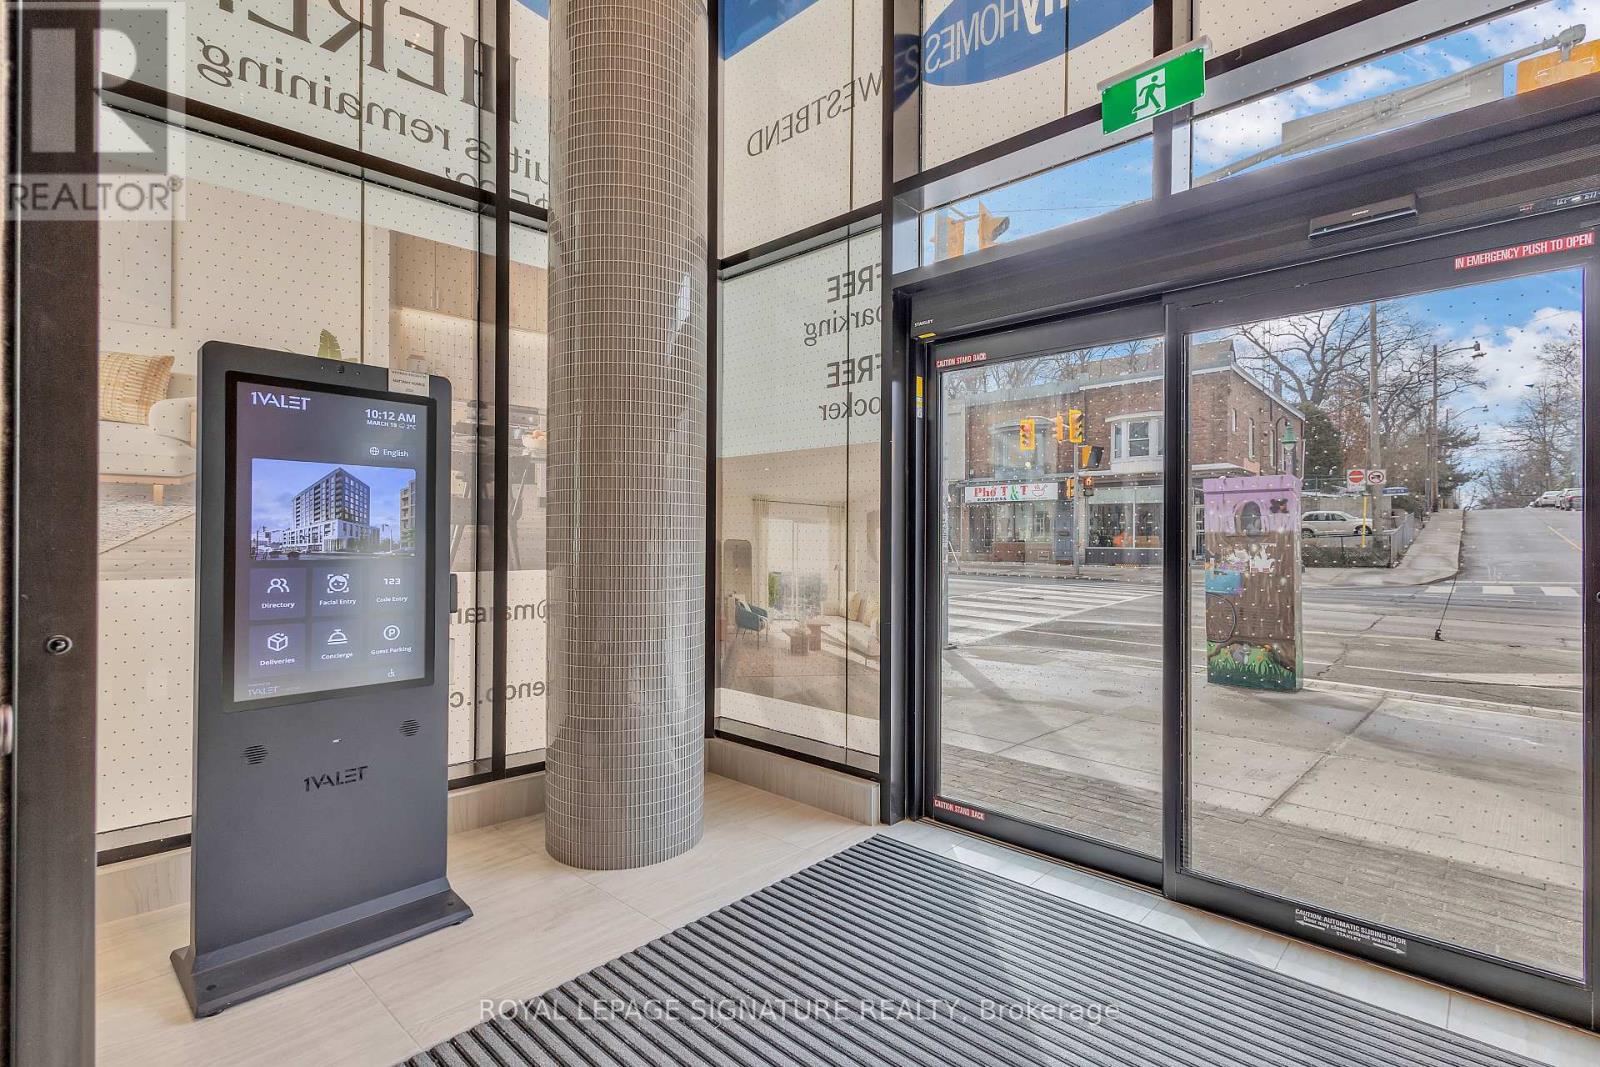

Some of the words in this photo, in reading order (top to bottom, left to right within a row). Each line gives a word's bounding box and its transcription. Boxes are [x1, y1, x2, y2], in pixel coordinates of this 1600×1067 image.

[1455, 258, 1465, 270] IN
[1467, 246, 1520, 267] EMERGENCY
[1522, 241, 1548, 257] PUSH
[1550, 238, 1564, 251] TO
[1566, 232, 1593, 248] OPEN
[935, 357, 956, 368] CAUTION
[250, 391, 311, 411] 1VALET
[364, 408, 396, 421] 10:12
[397, 412, 417, 424] AM
[366, 419, 389, 428] MARCH
[383, 447, 409, 458] English
[383, 577, 401, 585] 123
[389, 645, 412, 654] Parking
[259, 656, 296, 666] Deliveries
[321, 651, 354, 660] Concierge
[303, 765, 369, 792] 1VALET
[934, 799, 954, 812] CAUTION
[954, 805, 970, 817] STAND
[971, 809, 985, 821] BACK
[1323, 916, 1360, 932] AUTOMATIC
[1360, 927, 1387, 940] SLIDING
[1387, 934, 1407, 946] DOOR
